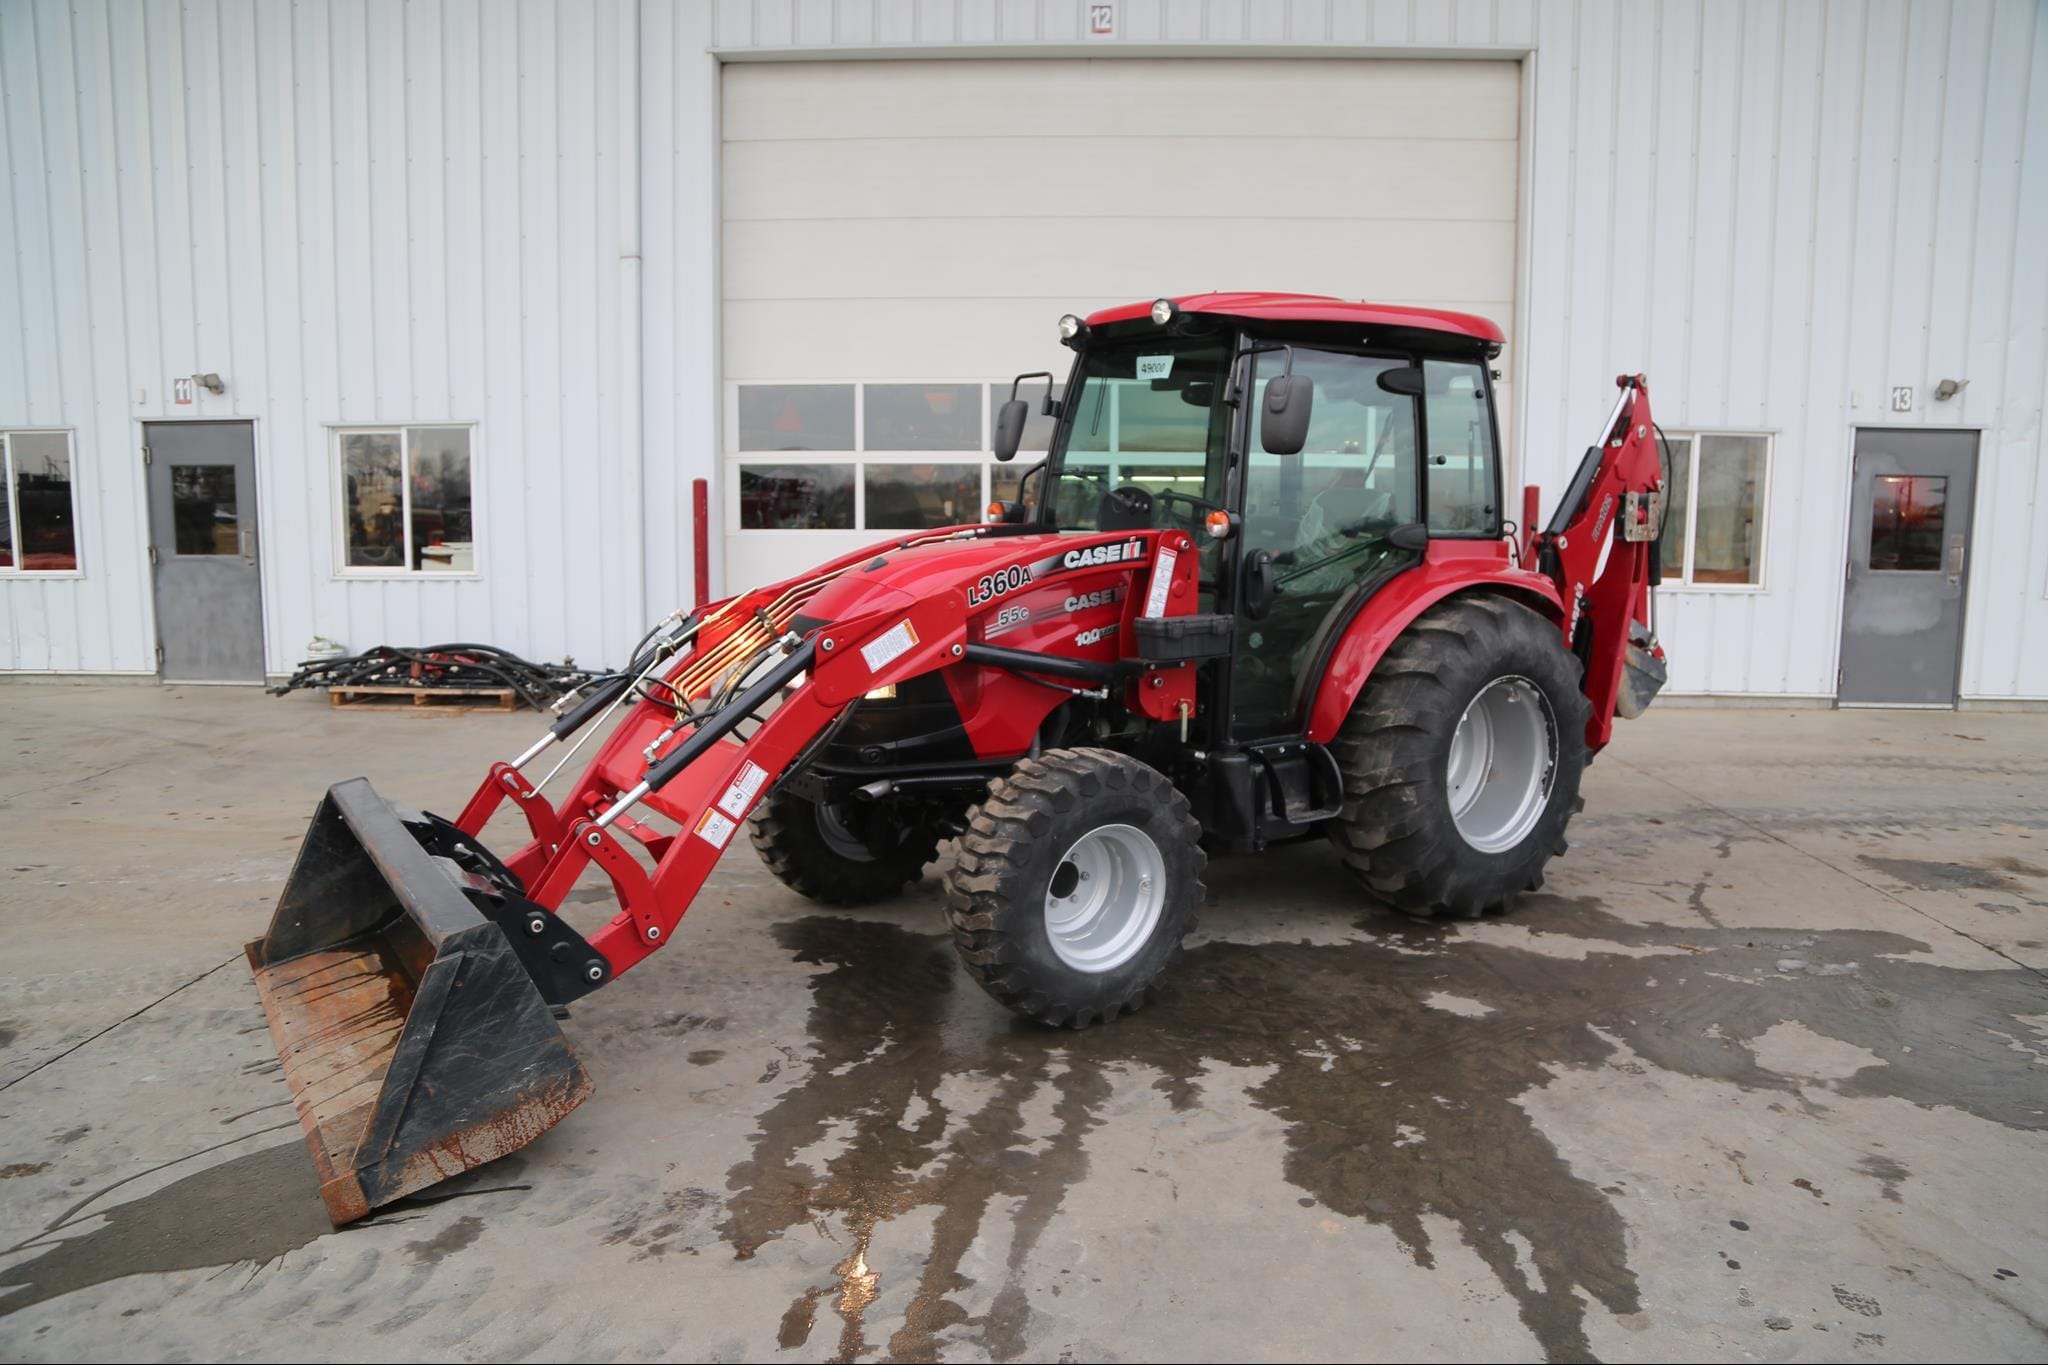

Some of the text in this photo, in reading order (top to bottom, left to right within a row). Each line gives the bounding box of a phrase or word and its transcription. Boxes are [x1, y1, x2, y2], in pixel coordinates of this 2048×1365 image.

[1092, 7, 1111, 28] 12
[175, 379, 190, 400] 11
[1893, 388, 1911, 410] 13
[968, 566, 1032, 607] L360A
